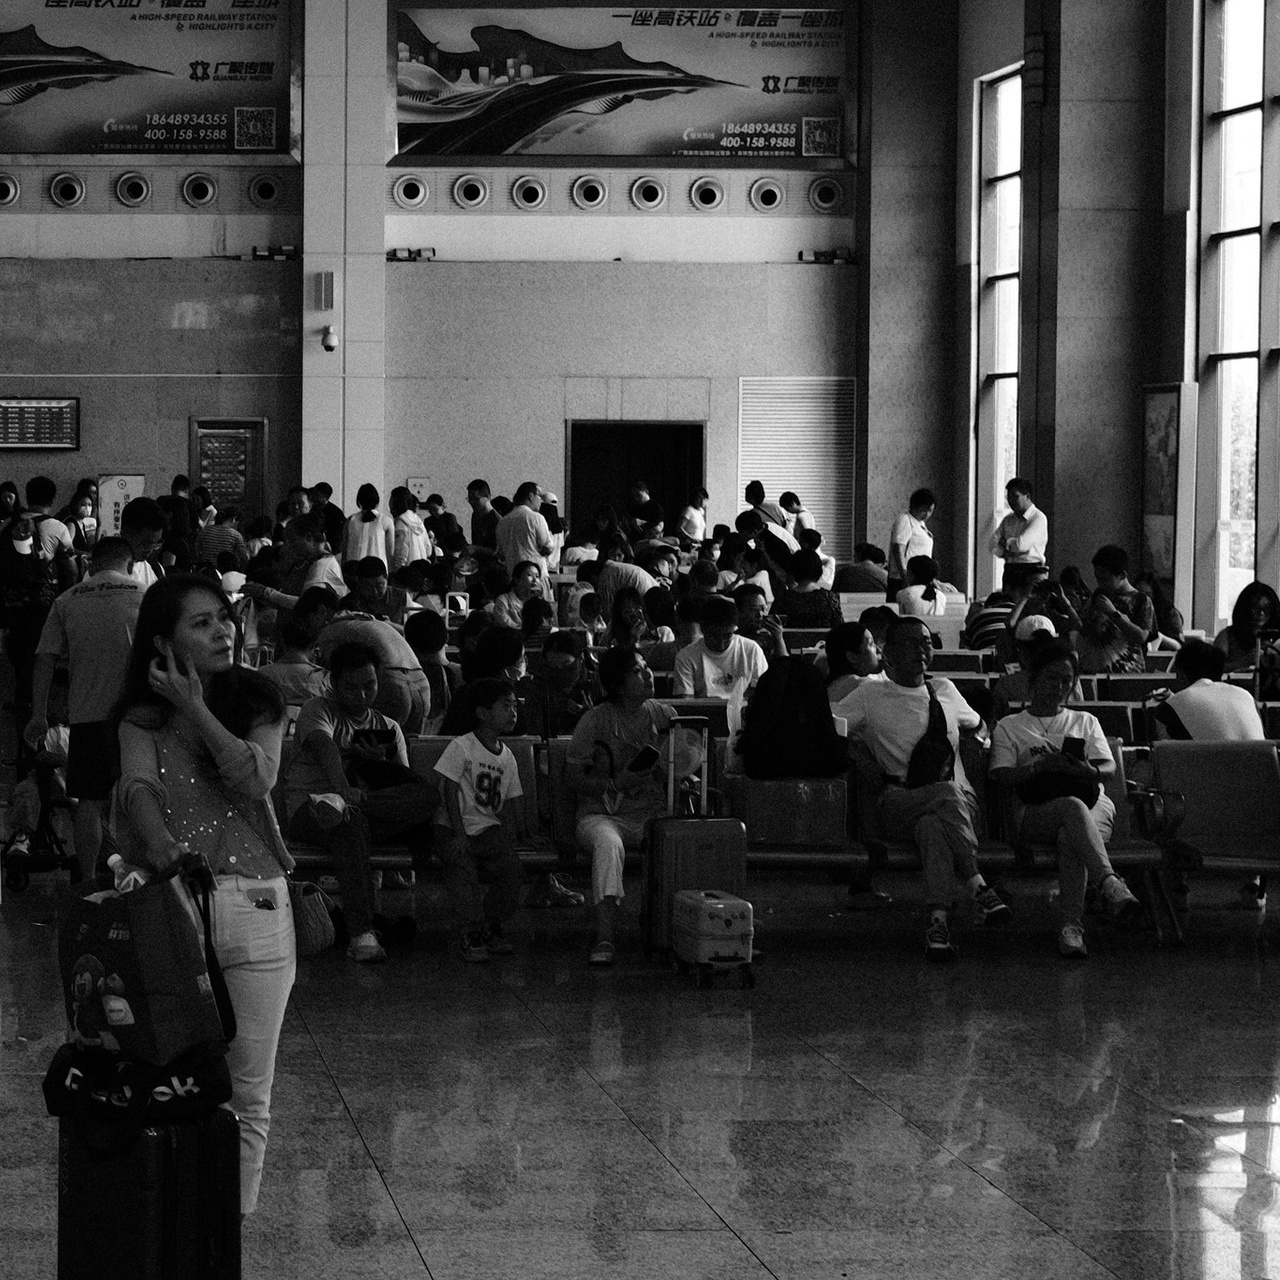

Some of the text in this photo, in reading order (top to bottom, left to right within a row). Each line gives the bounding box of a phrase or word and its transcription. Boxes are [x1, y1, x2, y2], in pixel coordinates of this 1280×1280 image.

[612, 9, 721, 27] 一座高铁站
[145, 114, 228, 125] 18648934355
[721, 123, 797, 134] 18648934355
[143, 129, 228, 140] 400-158-9588
[720, 137, 796, 148] 400-158-9588
[474, 771, 501, 812] 96
